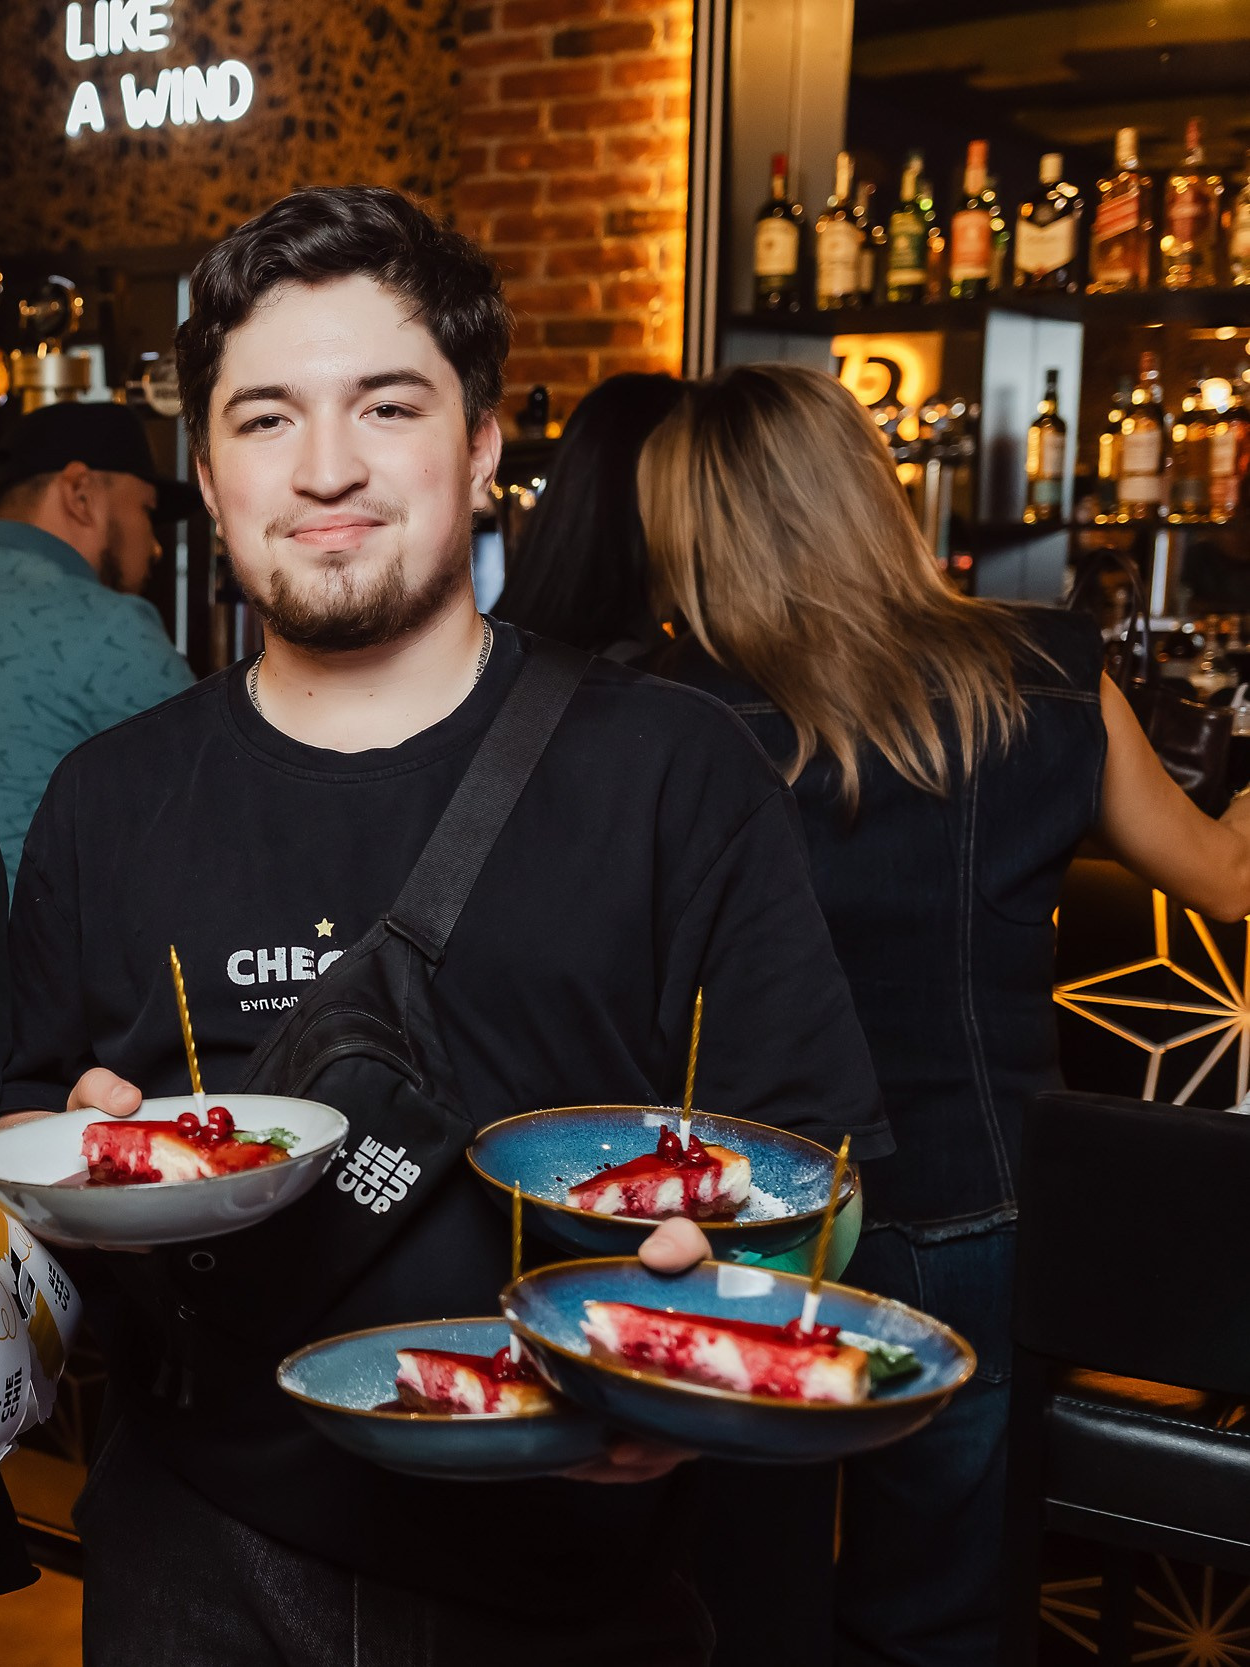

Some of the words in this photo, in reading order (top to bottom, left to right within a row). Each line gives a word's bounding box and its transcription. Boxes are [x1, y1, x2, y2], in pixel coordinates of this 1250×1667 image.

[66, 0, 173, 61] LIKE
[66, 81, 105, 137] A
[121, 60, 253, 129] WIND
[336, 1135, 382, 1192] CHE
[354, 1146, 406, 1205] CHIL
[370, 1160, 421, 1214] PUB
[1, 1374, 14, 1423] CHE
[10, 1366, 23, 1418] CHIL
